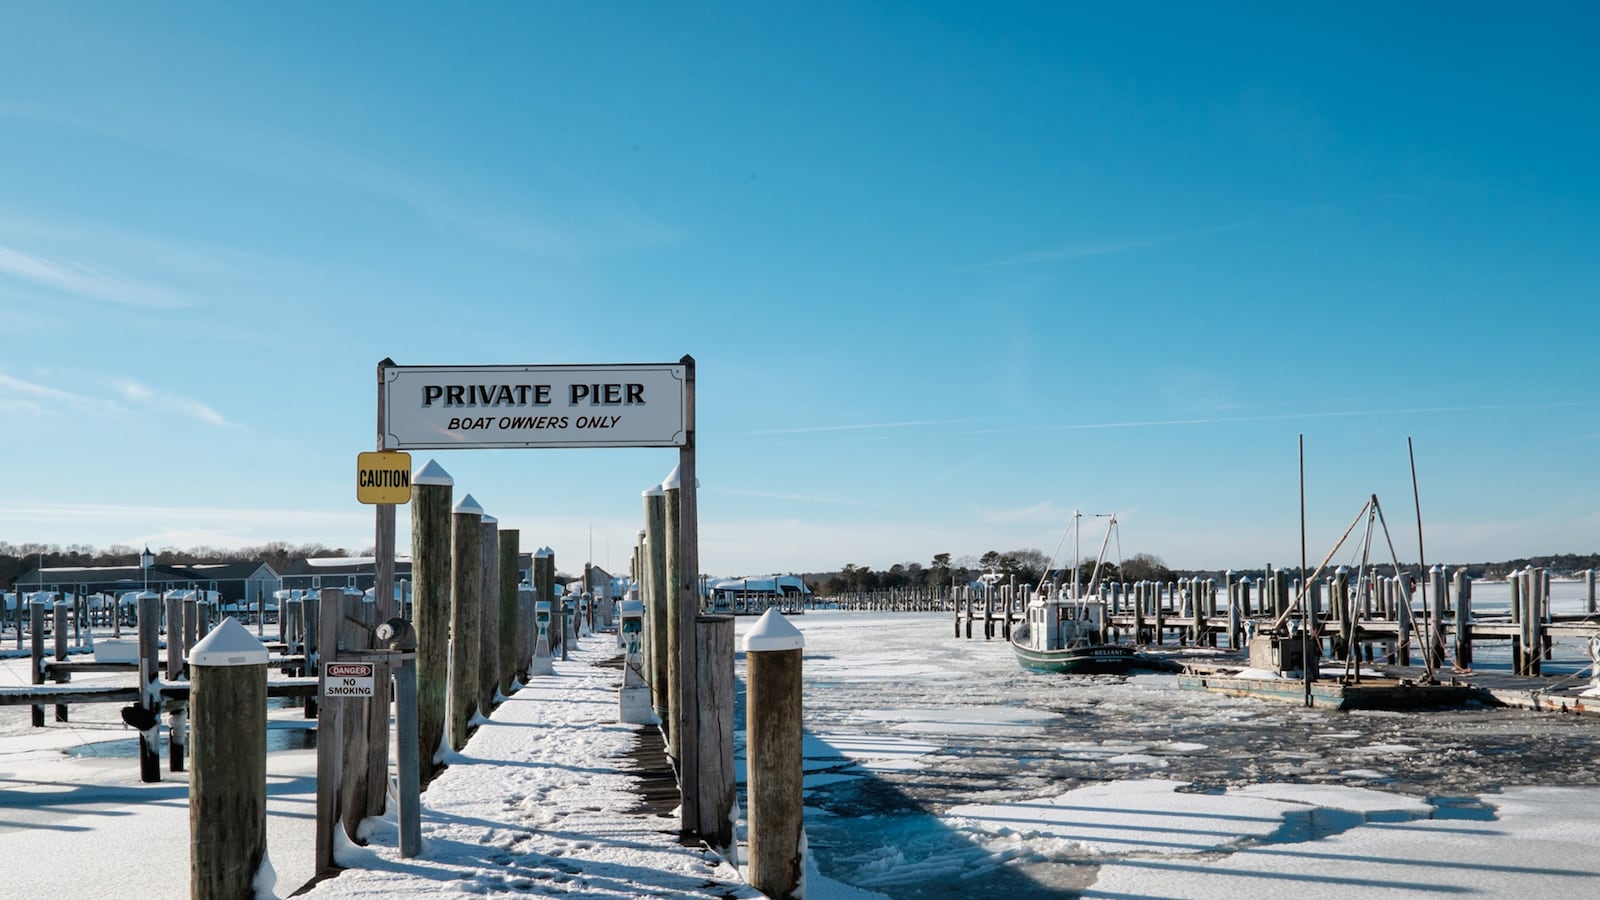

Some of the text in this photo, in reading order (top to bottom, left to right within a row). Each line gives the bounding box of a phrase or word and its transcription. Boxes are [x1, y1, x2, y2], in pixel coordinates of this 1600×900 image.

[423, 383, 646, 408] PRIVATE PIER
[448, 415, 622, 430] BOAT OWNERS ONLY
[359, 469, 410, 488] CAUTION
[333, 667, 367, 675] DANGER
[343, 678, 356, 686] NO
[328, 687, 371, 695] SMOKING
